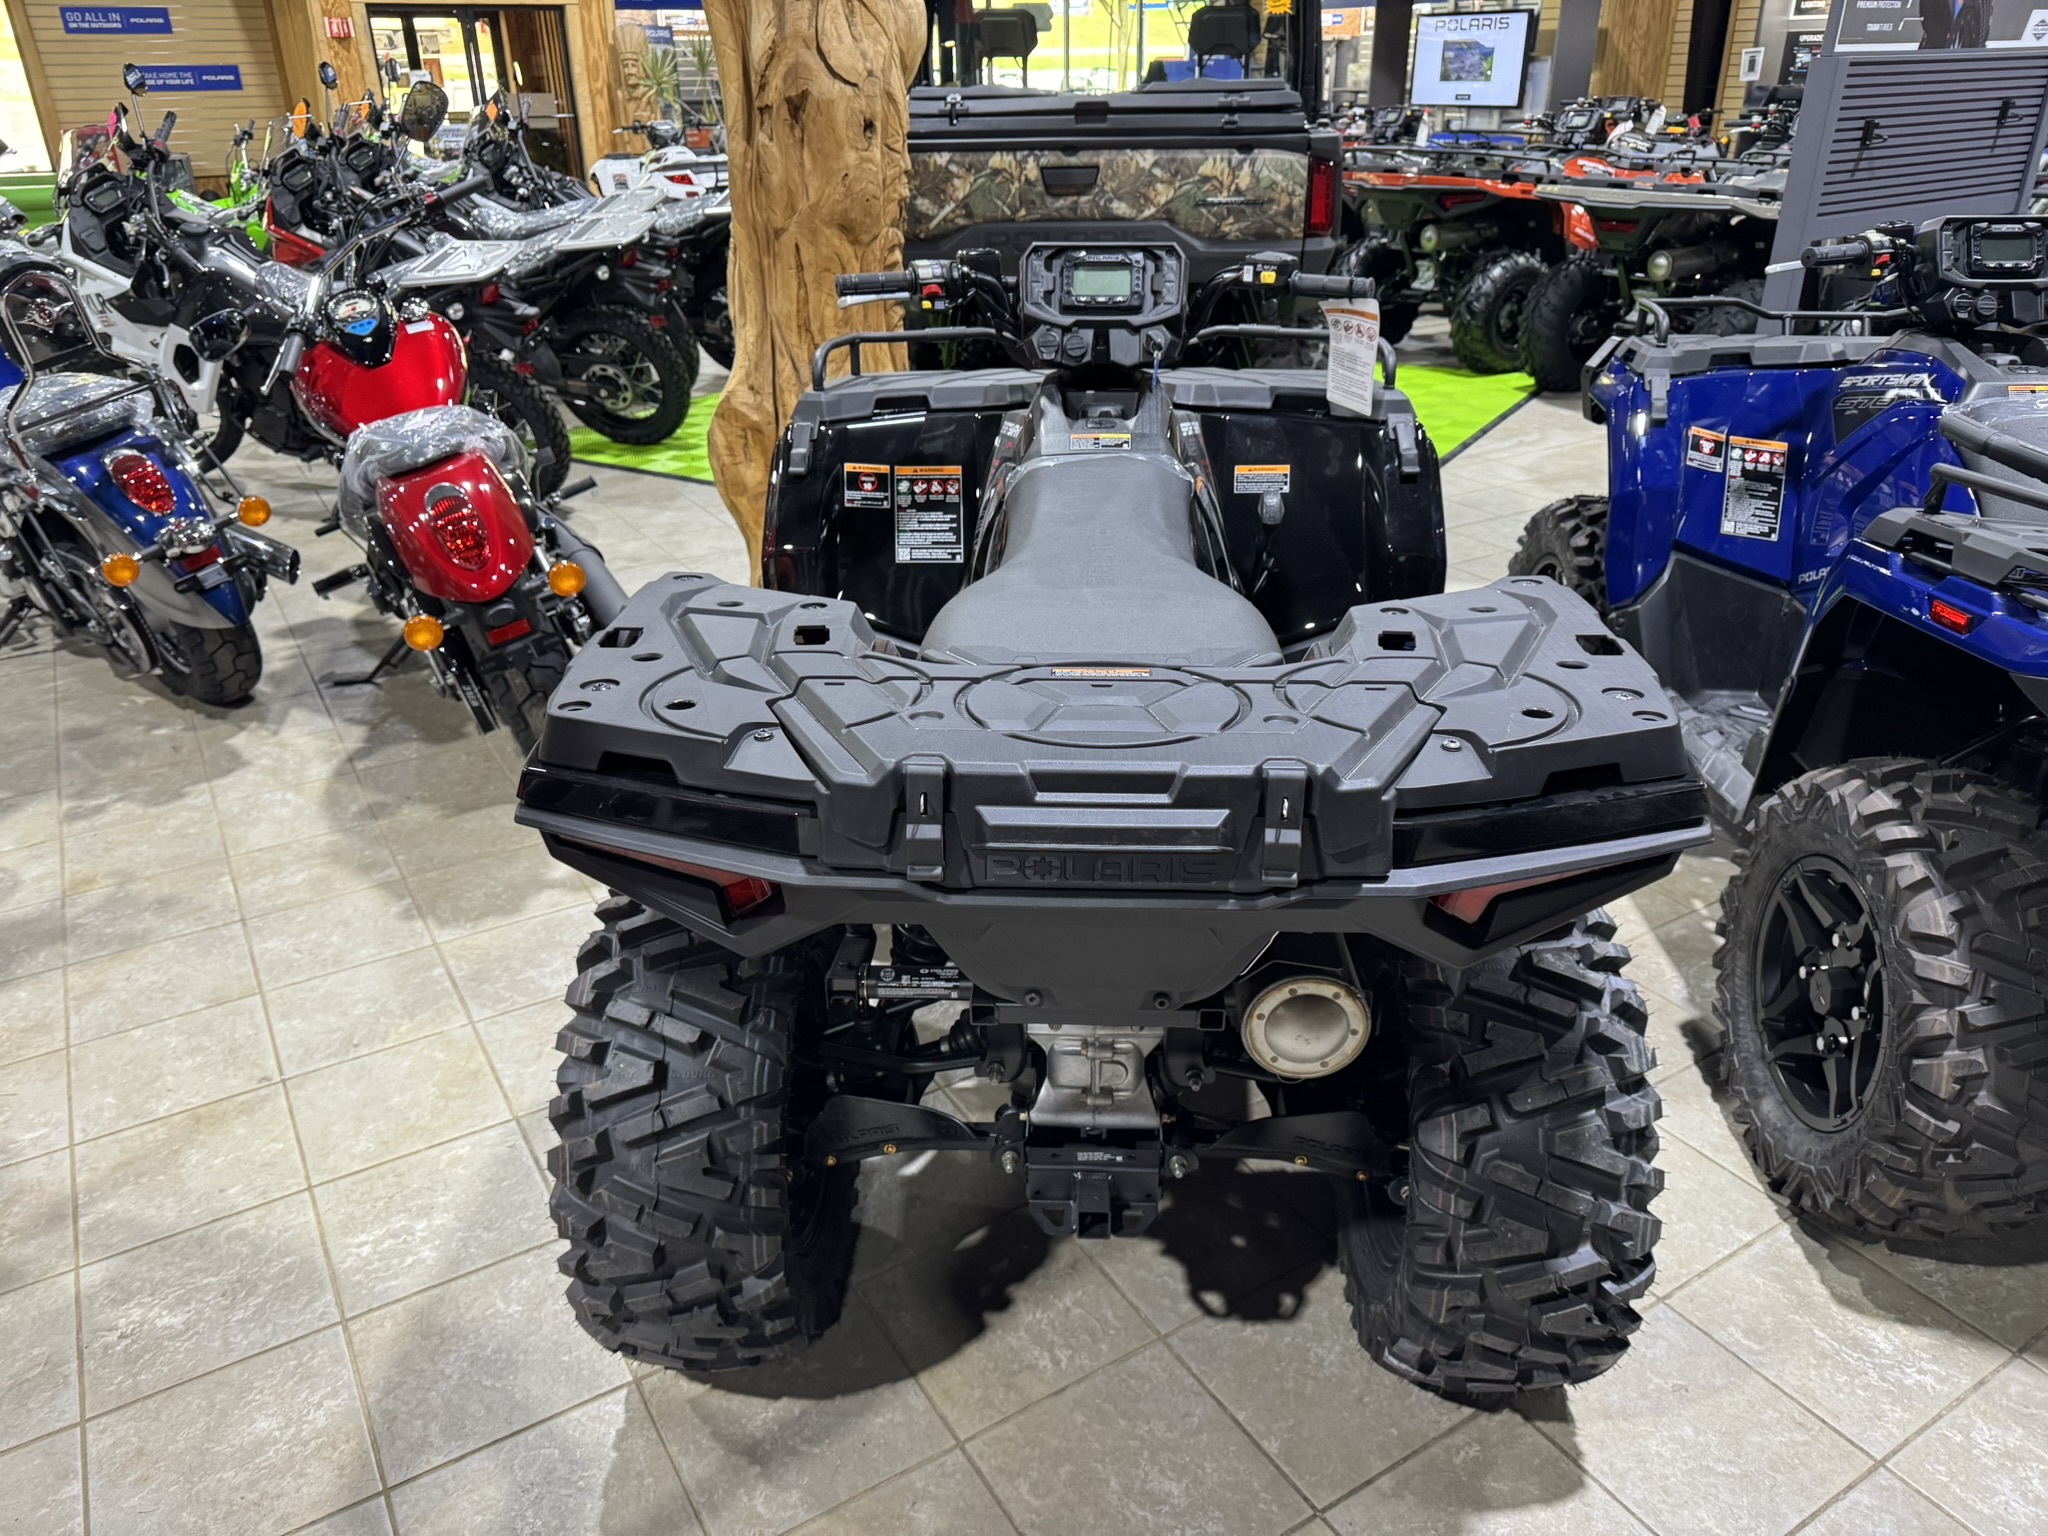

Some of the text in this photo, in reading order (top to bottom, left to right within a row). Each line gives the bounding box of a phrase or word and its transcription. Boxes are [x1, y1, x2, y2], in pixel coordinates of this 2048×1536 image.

[66, 12, 121, 22] GO ALL IN
[1435, 17, 1510, 32] POLARIS
[1839, 373, 1937, 387] SPORTSMAN
[1834, 396, 1897, 409] 570
[984, 855, 1218, 884] POLARIS
